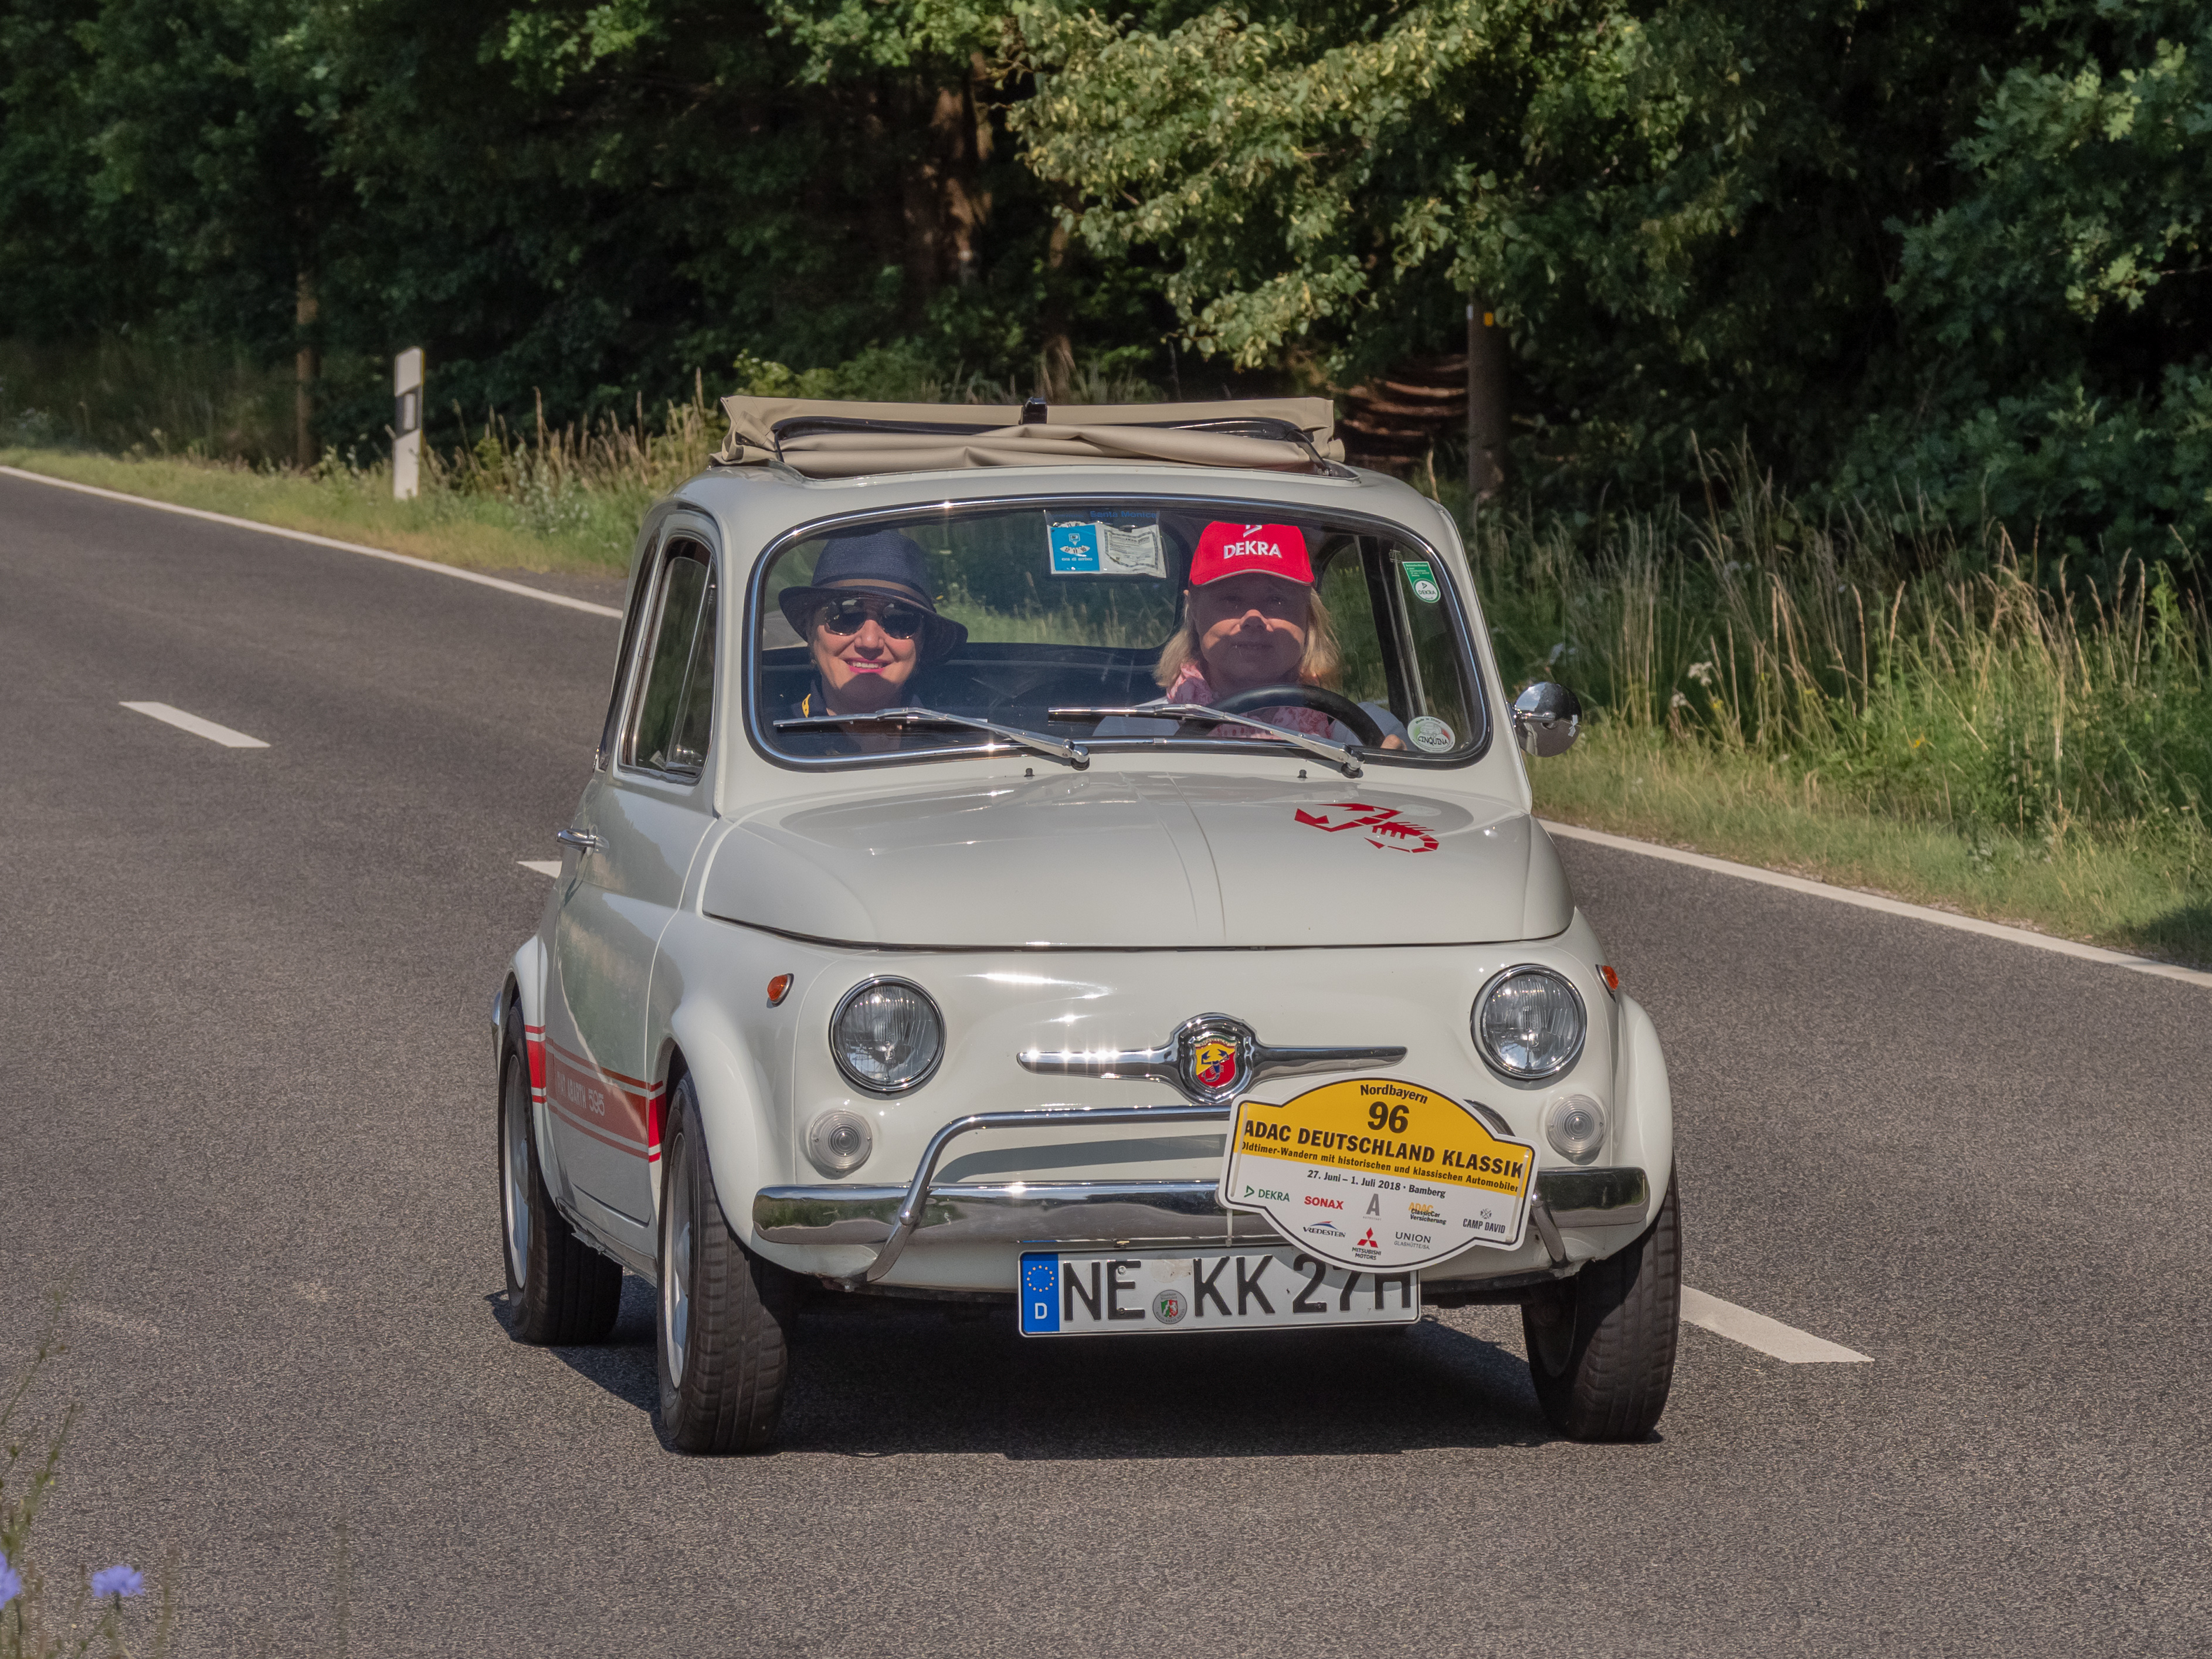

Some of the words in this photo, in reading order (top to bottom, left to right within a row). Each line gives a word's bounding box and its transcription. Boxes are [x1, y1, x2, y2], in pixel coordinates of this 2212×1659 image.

[1121, 511, 1156, 519] Monica
[1223, 540, 1282, 559] DEKRA
[1417, 736, 1448, 746] CINQUINA
[1361, 1084, 1429, 1104] Nordbayern
[588, 1088, 605, 1117] 595
[1368, 1101, 1410, 1134] 96
[1244, 1119, 1291, 1142] ADAC
[1298, 1127, 1435, 1163] DEUTSCHLAND
[1441, 1149, 1524, 1179] KLASSIK
[1321, 1154, 1335, 1163] mit
[1338, 1155, 1391, 1172] historischen
[1395, 1166, 1410, 1174] und
[1413, 1166, 1463, 1181] klassischen
[1307, 1169, 1321, 1180] 27.
[1323, 1172, 1341, 1183] Juni
[1351, 1176, 1359, 1185] 1.
[1361, 1178, 1376, 1188] Juli
[1378, 1180, 1401, 1191] 2018
[1409, 1184, 1446, 1199] Bamberg
[1258, 1189, 1290, 1202] DEKRA
[1304, 1196, 1344, 1210] SONAX
[1366, 1193, 1380, 1216] A
[1407, 1202, 1434, 1213] ADAC
[1410, 1214, 1447, 1226] Versicherung
[1411, 1208, 1440, 1218] ClassicCar
[1302, 1226, 1346, 1239] VREDESTEIN
[1463, 1218, 1483, 1230] CAMP
[1484, 1222, 1506, 1234] DAVID
[1395, 1231, 1431, 1244] UNION
[1352, 1247, 1382, 1256] MITSUBISHI
[1063, 1260, 1146, 1322] NE
[1193, 1254, 1275, 1317] KK
[1292, 1253, 1412, 1314] 27H
[1034, 1303, 1048, 1319] D
